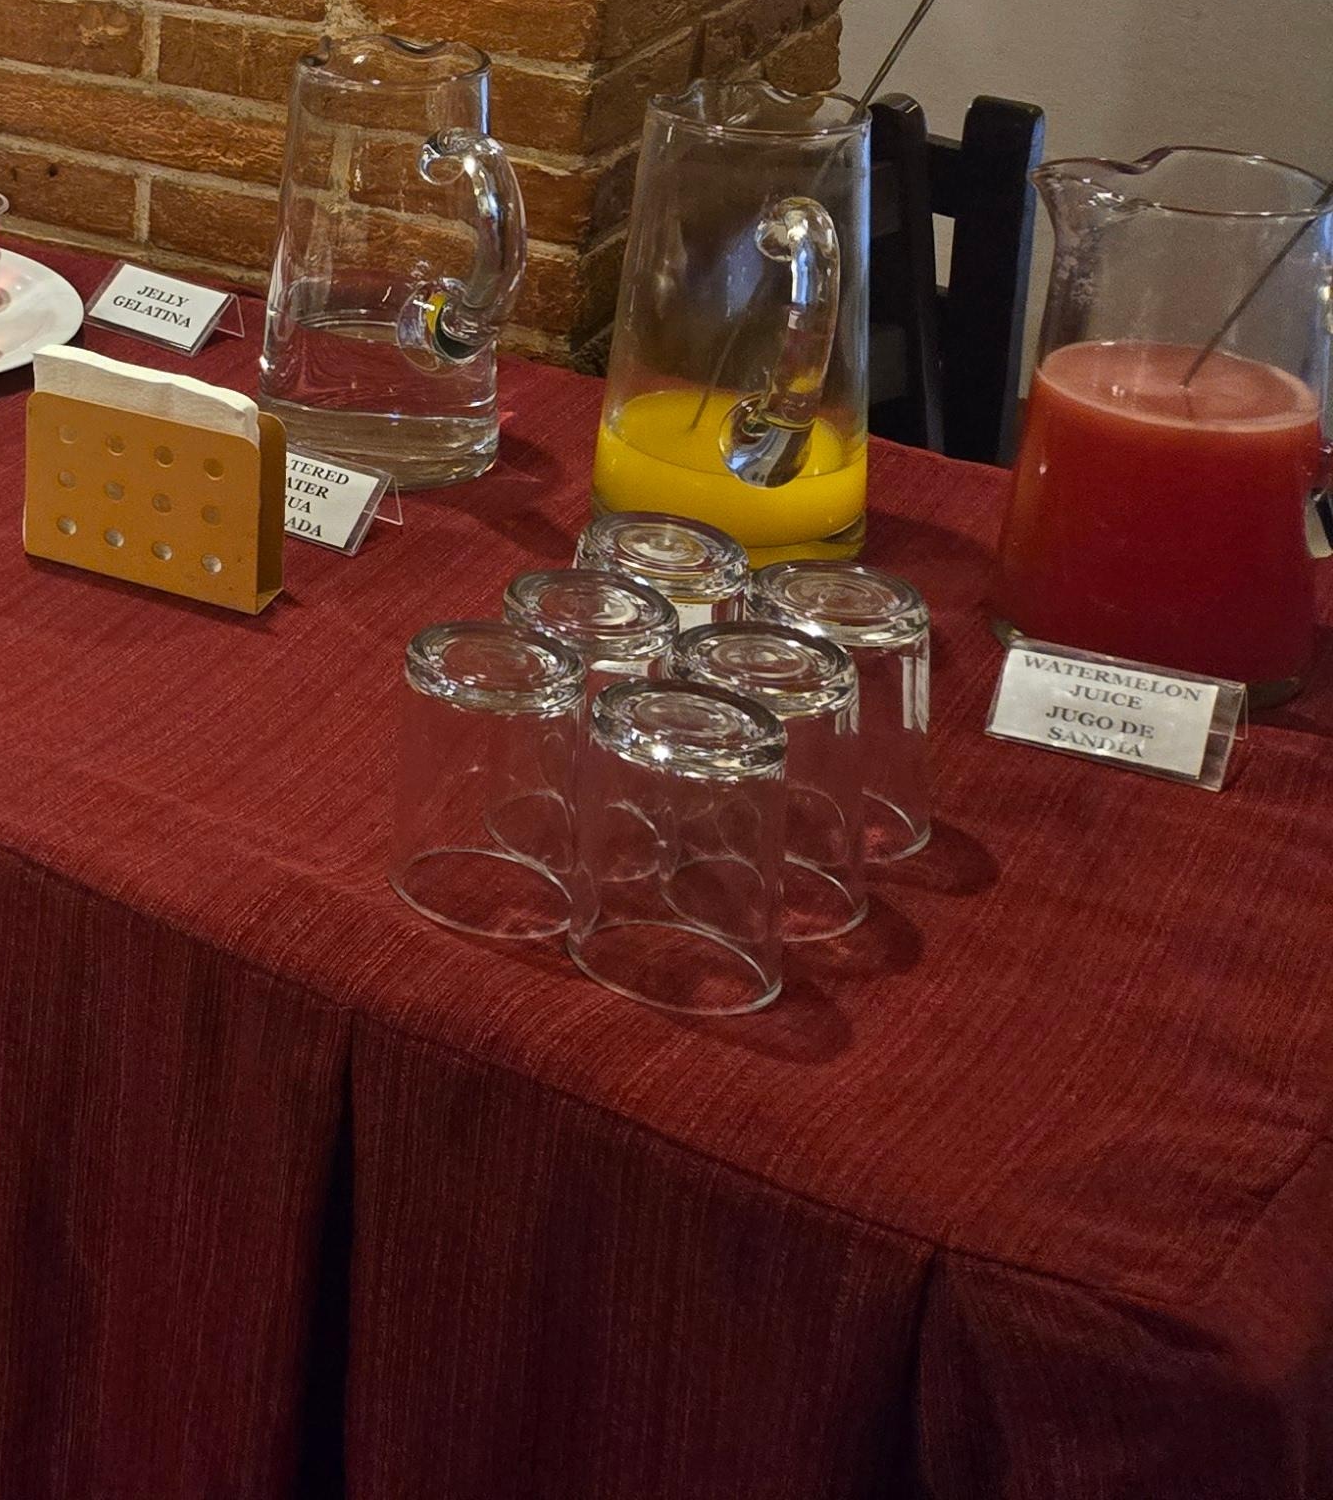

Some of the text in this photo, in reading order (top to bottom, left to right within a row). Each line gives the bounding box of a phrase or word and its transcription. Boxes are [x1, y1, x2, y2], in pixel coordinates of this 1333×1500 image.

[137, 286, 189, 308] JELLY
[113, 295, 192, 328] GELATINA
[286, 476, 330, 500] ATER
[285, 495, 311, 514] UA
[285, 516, 322, 538] ADA
[1023, 654, 1202, 702] WATERMELON
[1069, 684, 1143, 710] JUICE
[1045, 705, 1155, 740] JUGO DE
